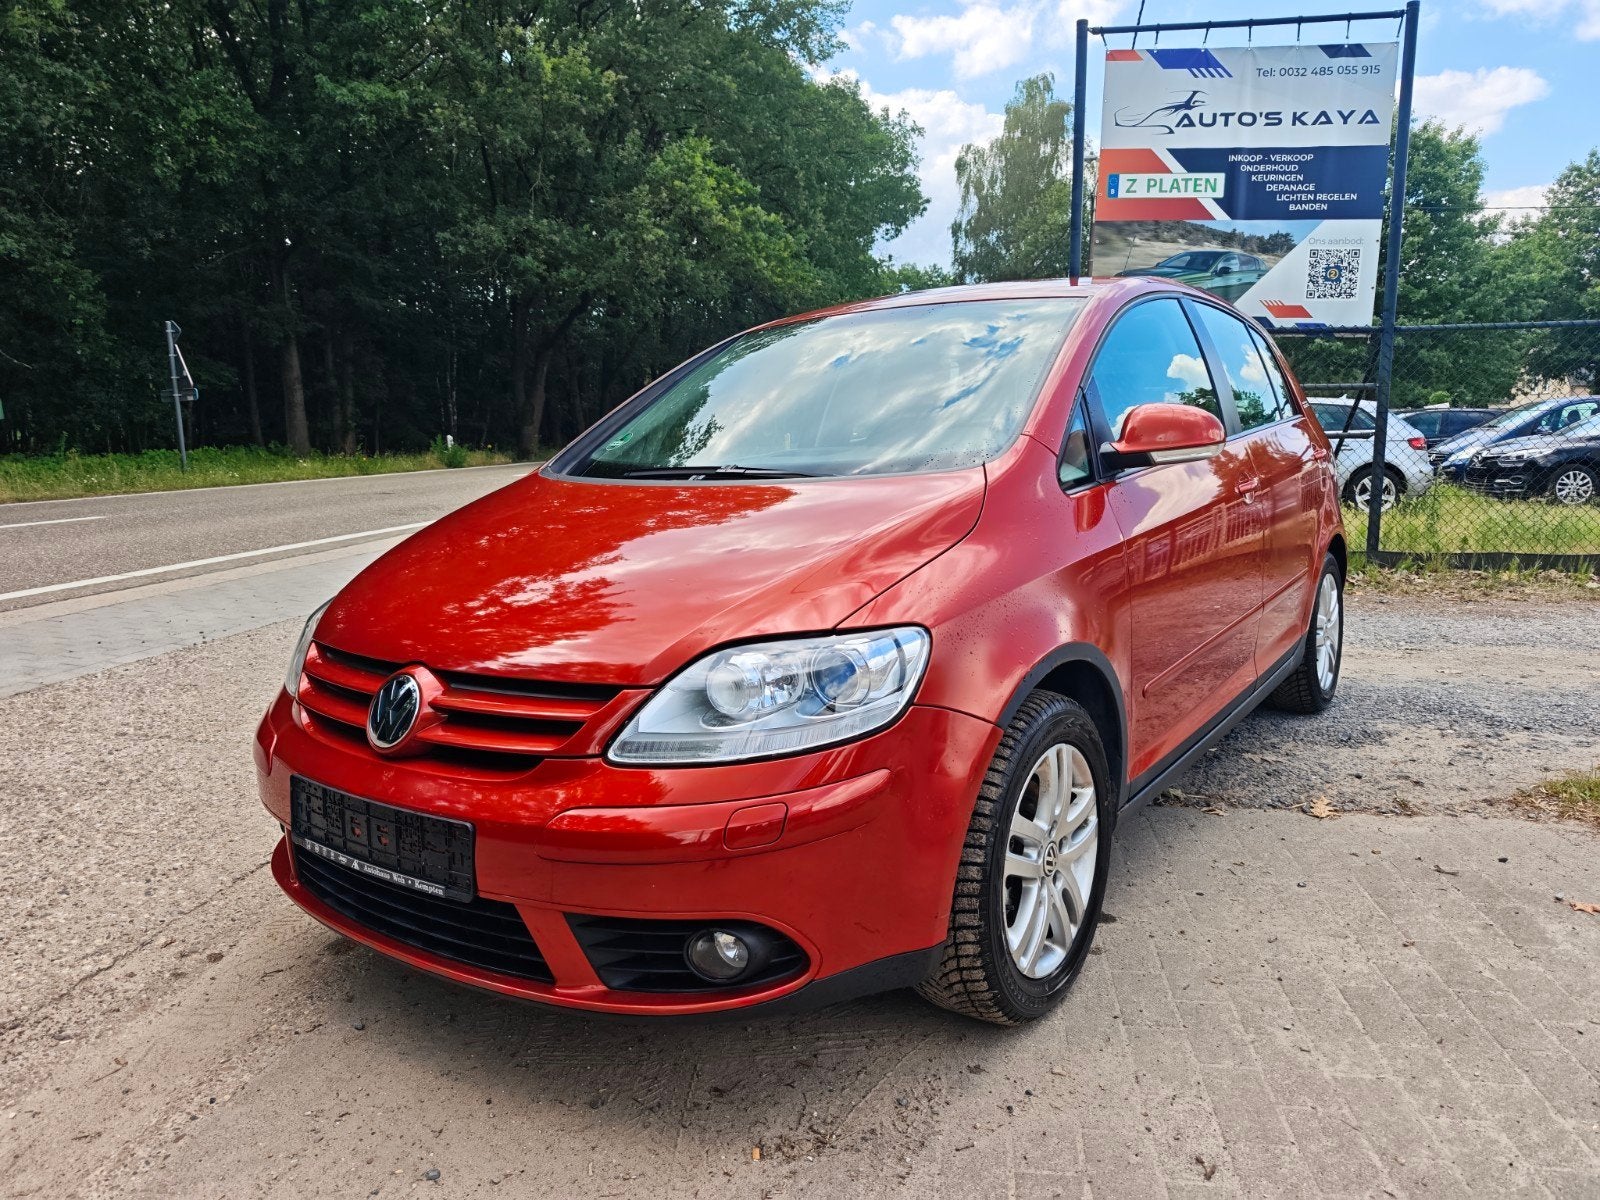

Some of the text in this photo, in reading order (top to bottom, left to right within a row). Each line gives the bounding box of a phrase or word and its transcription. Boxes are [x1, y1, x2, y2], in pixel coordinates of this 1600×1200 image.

[1256, 64, 1381, 78] Tel: 0032 485 055 915
[1175, 109, 1381, 128] AUTO'S KAYA
[1228, 154, 1263, 162] INKOOP
[1270, 153, 1314, 162] VERKOOP
[1240, 164, 1299, 172] ONDERHOUD
[1251, 174, 1304, 182] KEURINGEN
[1125, 177, 1218, 194] Z PLATEN
[1266, 183, 1316, 191] DEPANAGE
[1276, 193, 1358, 202] LICHTEN REGELEN
[1289, 203, 1328, 211] BANDEN
[1308, 237, 1326, 245] Ons
